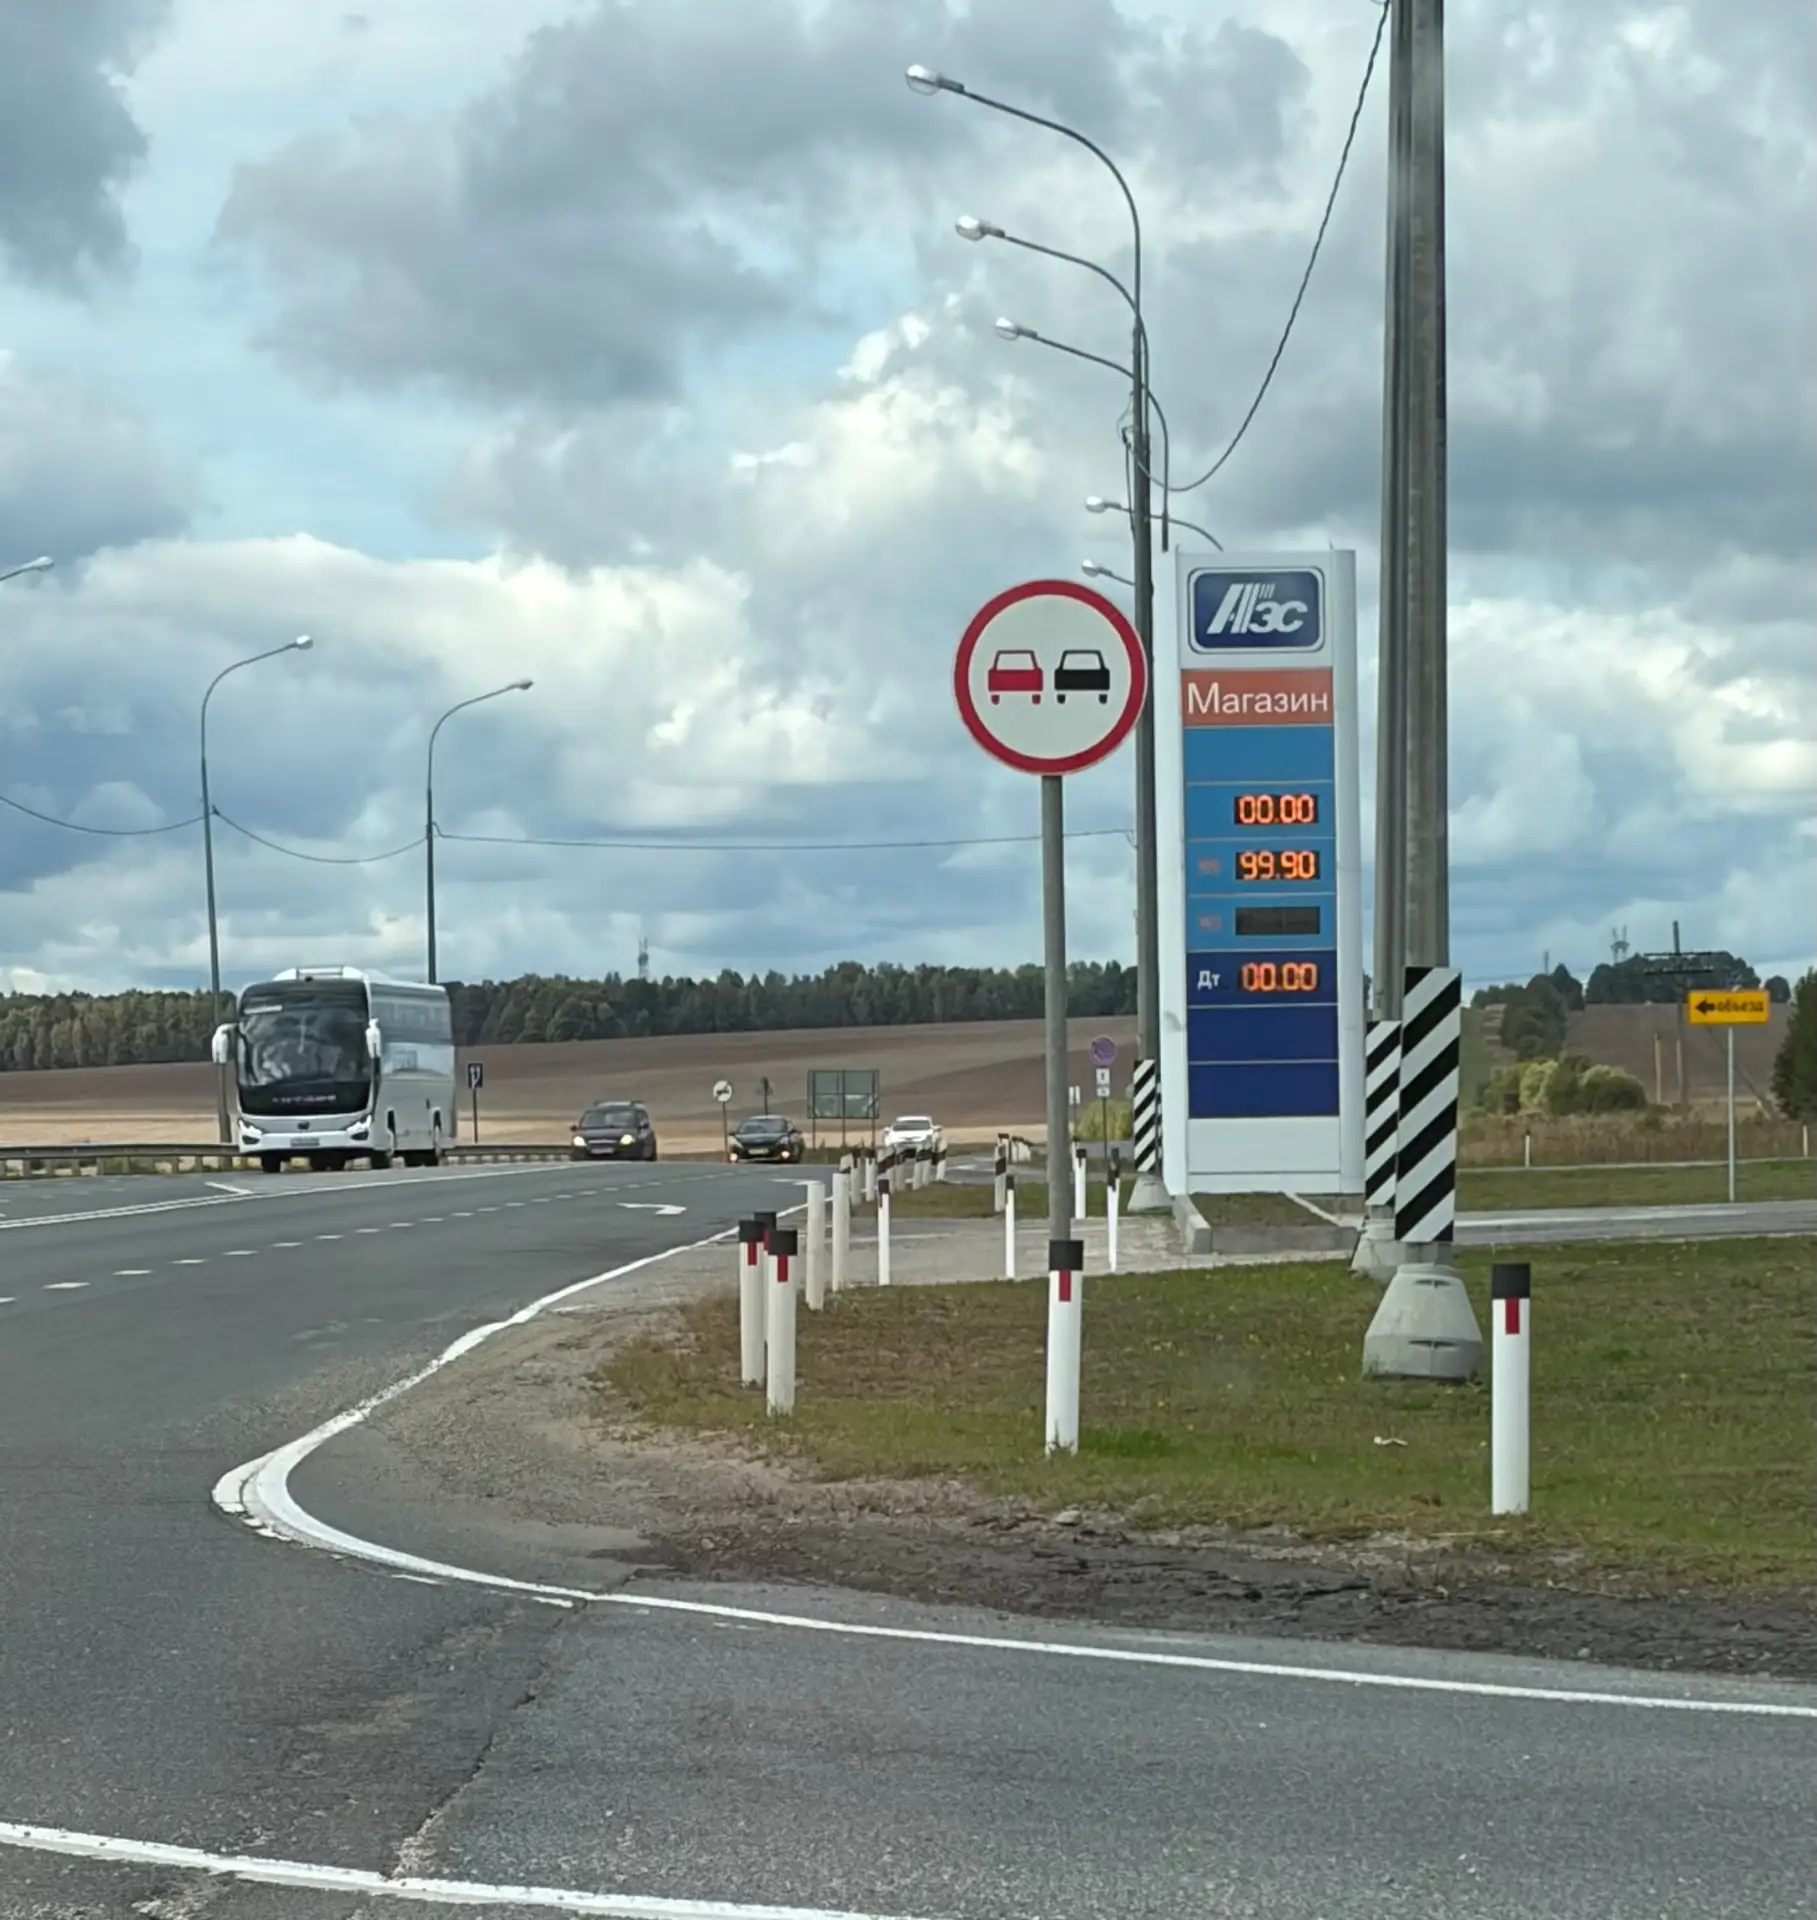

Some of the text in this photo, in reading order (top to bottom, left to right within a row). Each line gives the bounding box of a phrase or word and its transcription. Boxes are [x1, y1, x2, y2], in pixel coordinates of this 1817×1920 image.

[1206, 583, 1308, 634] АЗС
[1187, 682, 1328, 714] Магазин
[1239, 794, 1314, 824] 00.00
[1240, 851, 1315, 880] 99.90
[1197, 962, 1317, 991] Дт 00.00
